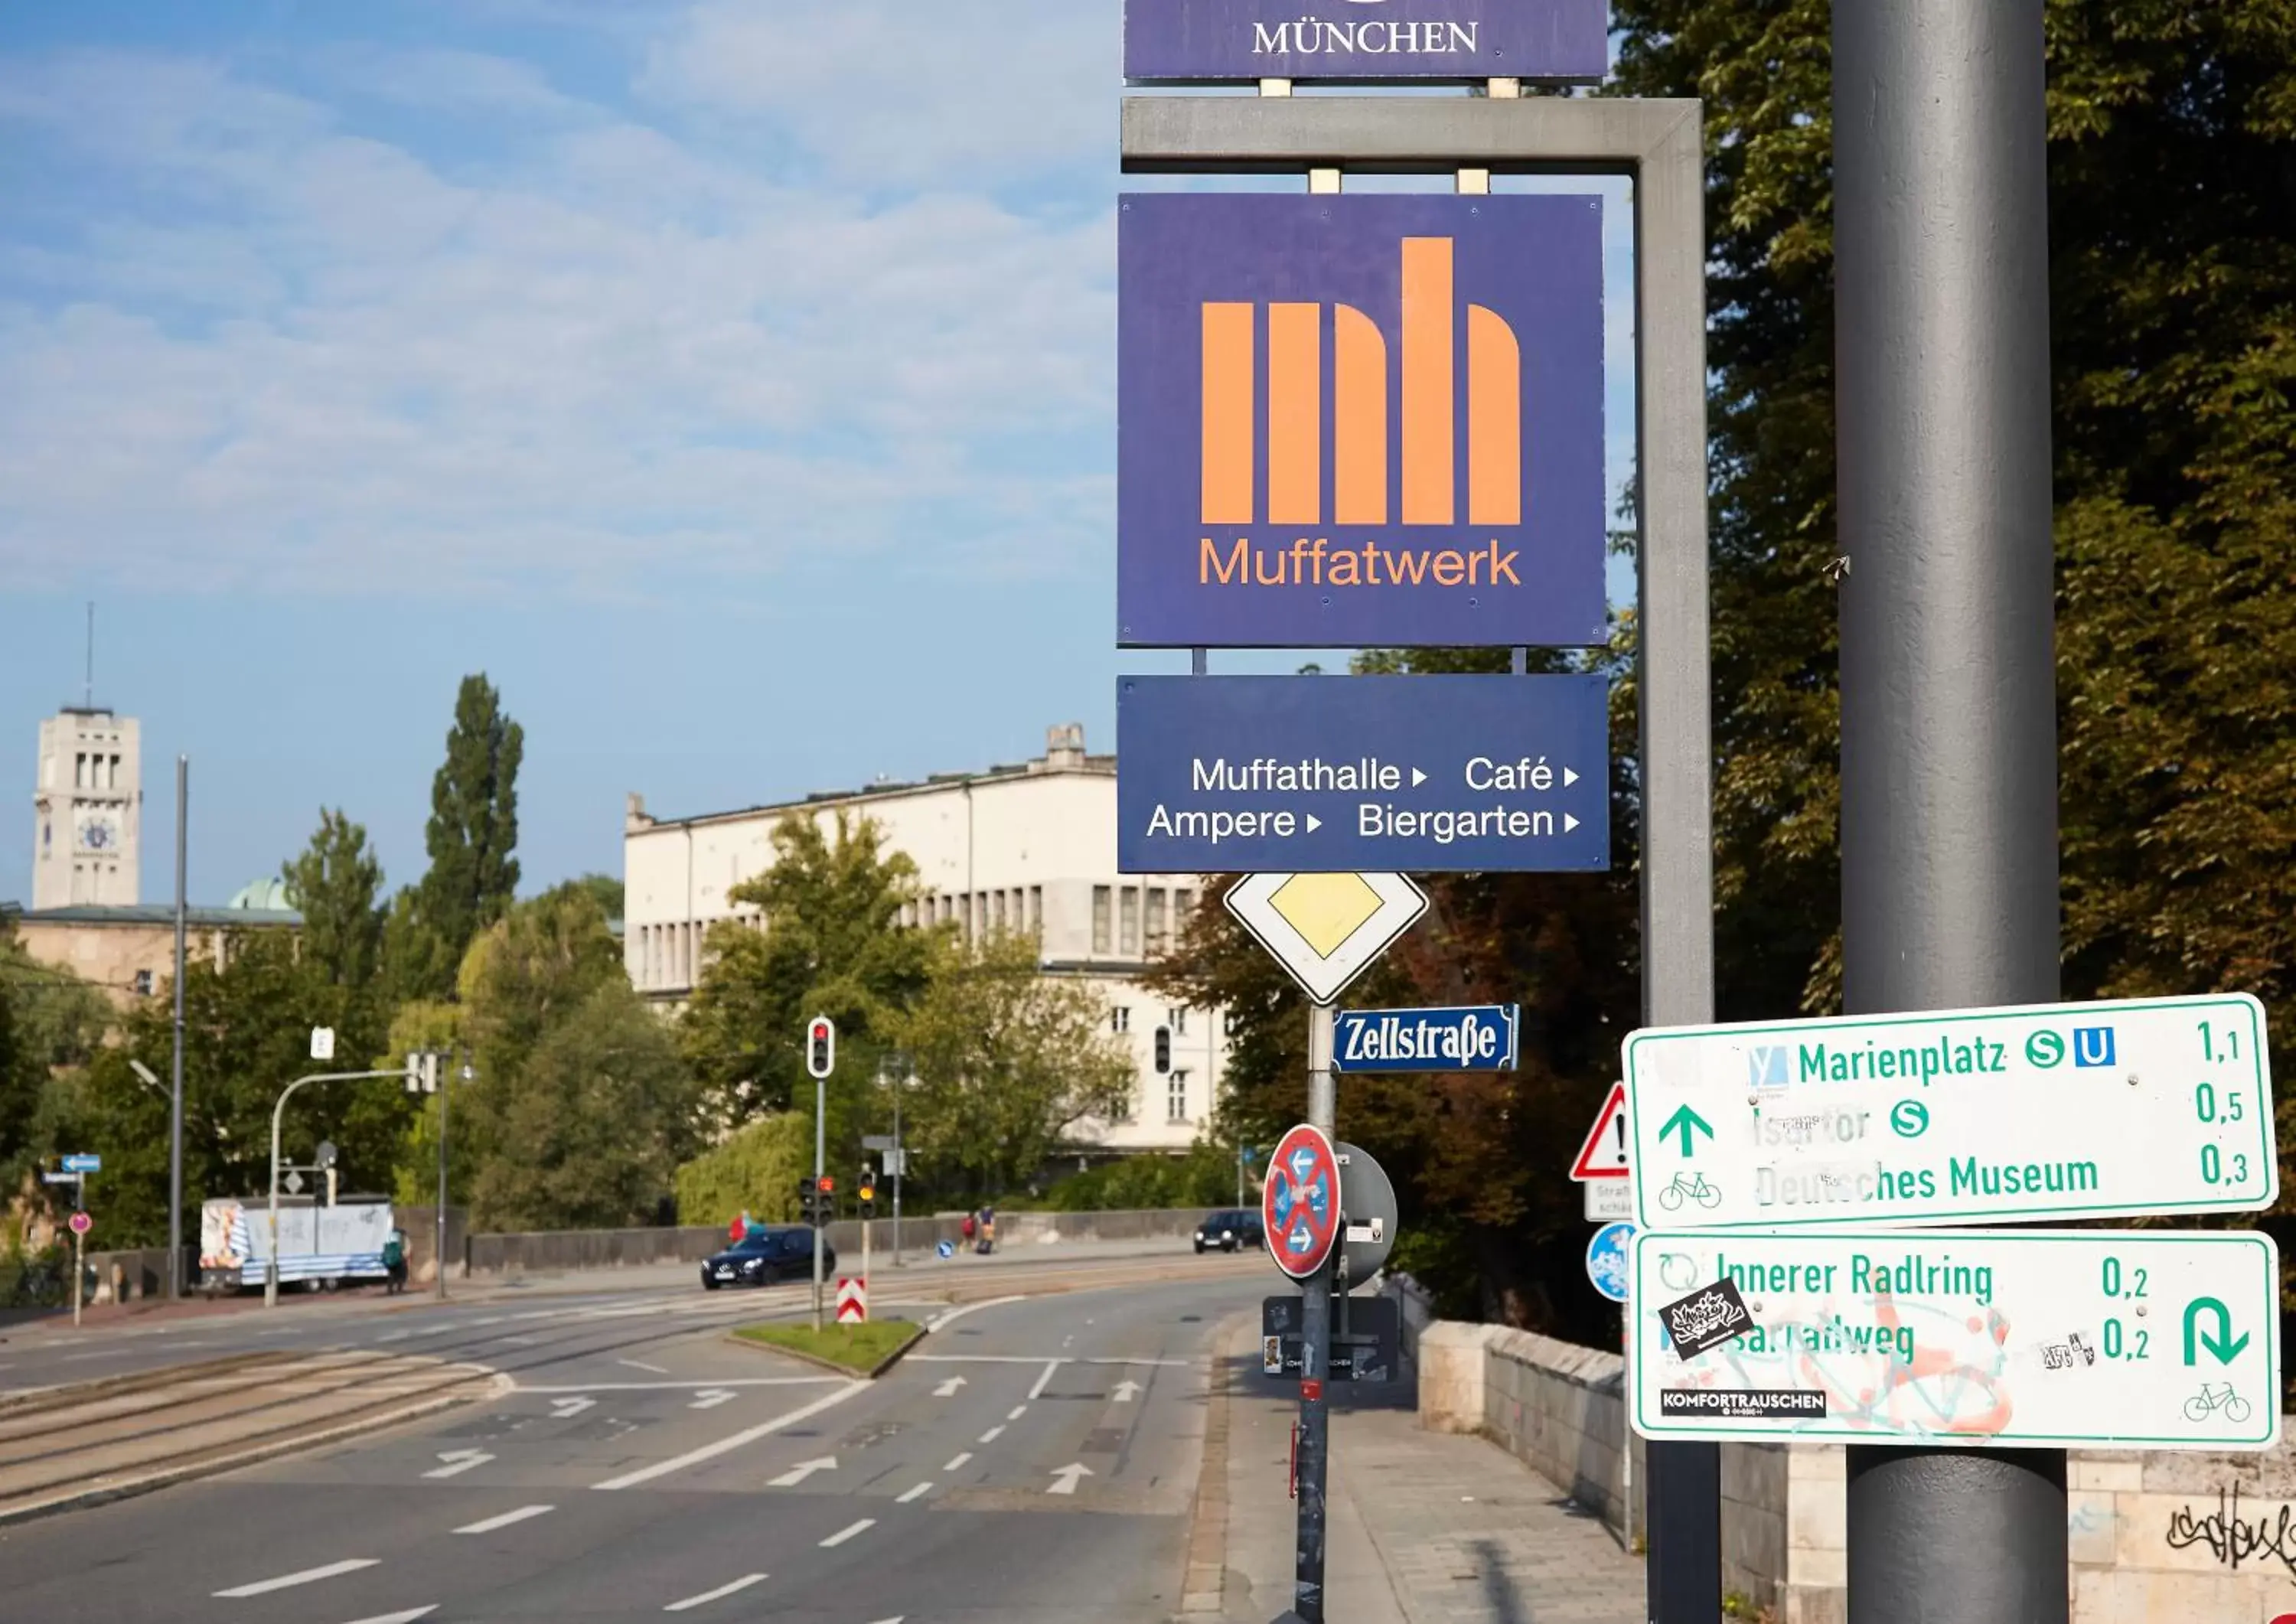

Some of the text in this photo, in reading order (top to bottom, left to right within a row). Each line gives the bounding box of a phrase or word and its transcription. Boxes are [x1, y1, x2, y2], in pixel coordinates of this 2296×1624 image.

[1252, 17, 1478, 53] MÜNCHEN
[1199, 538, 1521, 585] Muffatwerk
[1192, 756, 1553, 791] Muffathalle Café
[1146, 804, 1554, 844] Ampere Biergarten
[1345, 1014, 1495, 1068] Zellstraße
[1799, 1035, 2007, 1087] Marienplatz
[2197, 1021, 2238, 1064] 1,1
[2195, 1081, 2243, 1125] 0,5
[1949, 1156, 2099, 1197] Museum
[2200, 1143, 2248, 1186] 0,3
[1717, 1253, 2148, 1306] Innerer Radlring 0,2
[2102, 1317, 2149, 1361] 0,2
[1662, 1392, 1825, 1410] KOMFORTRAUSCHEN
